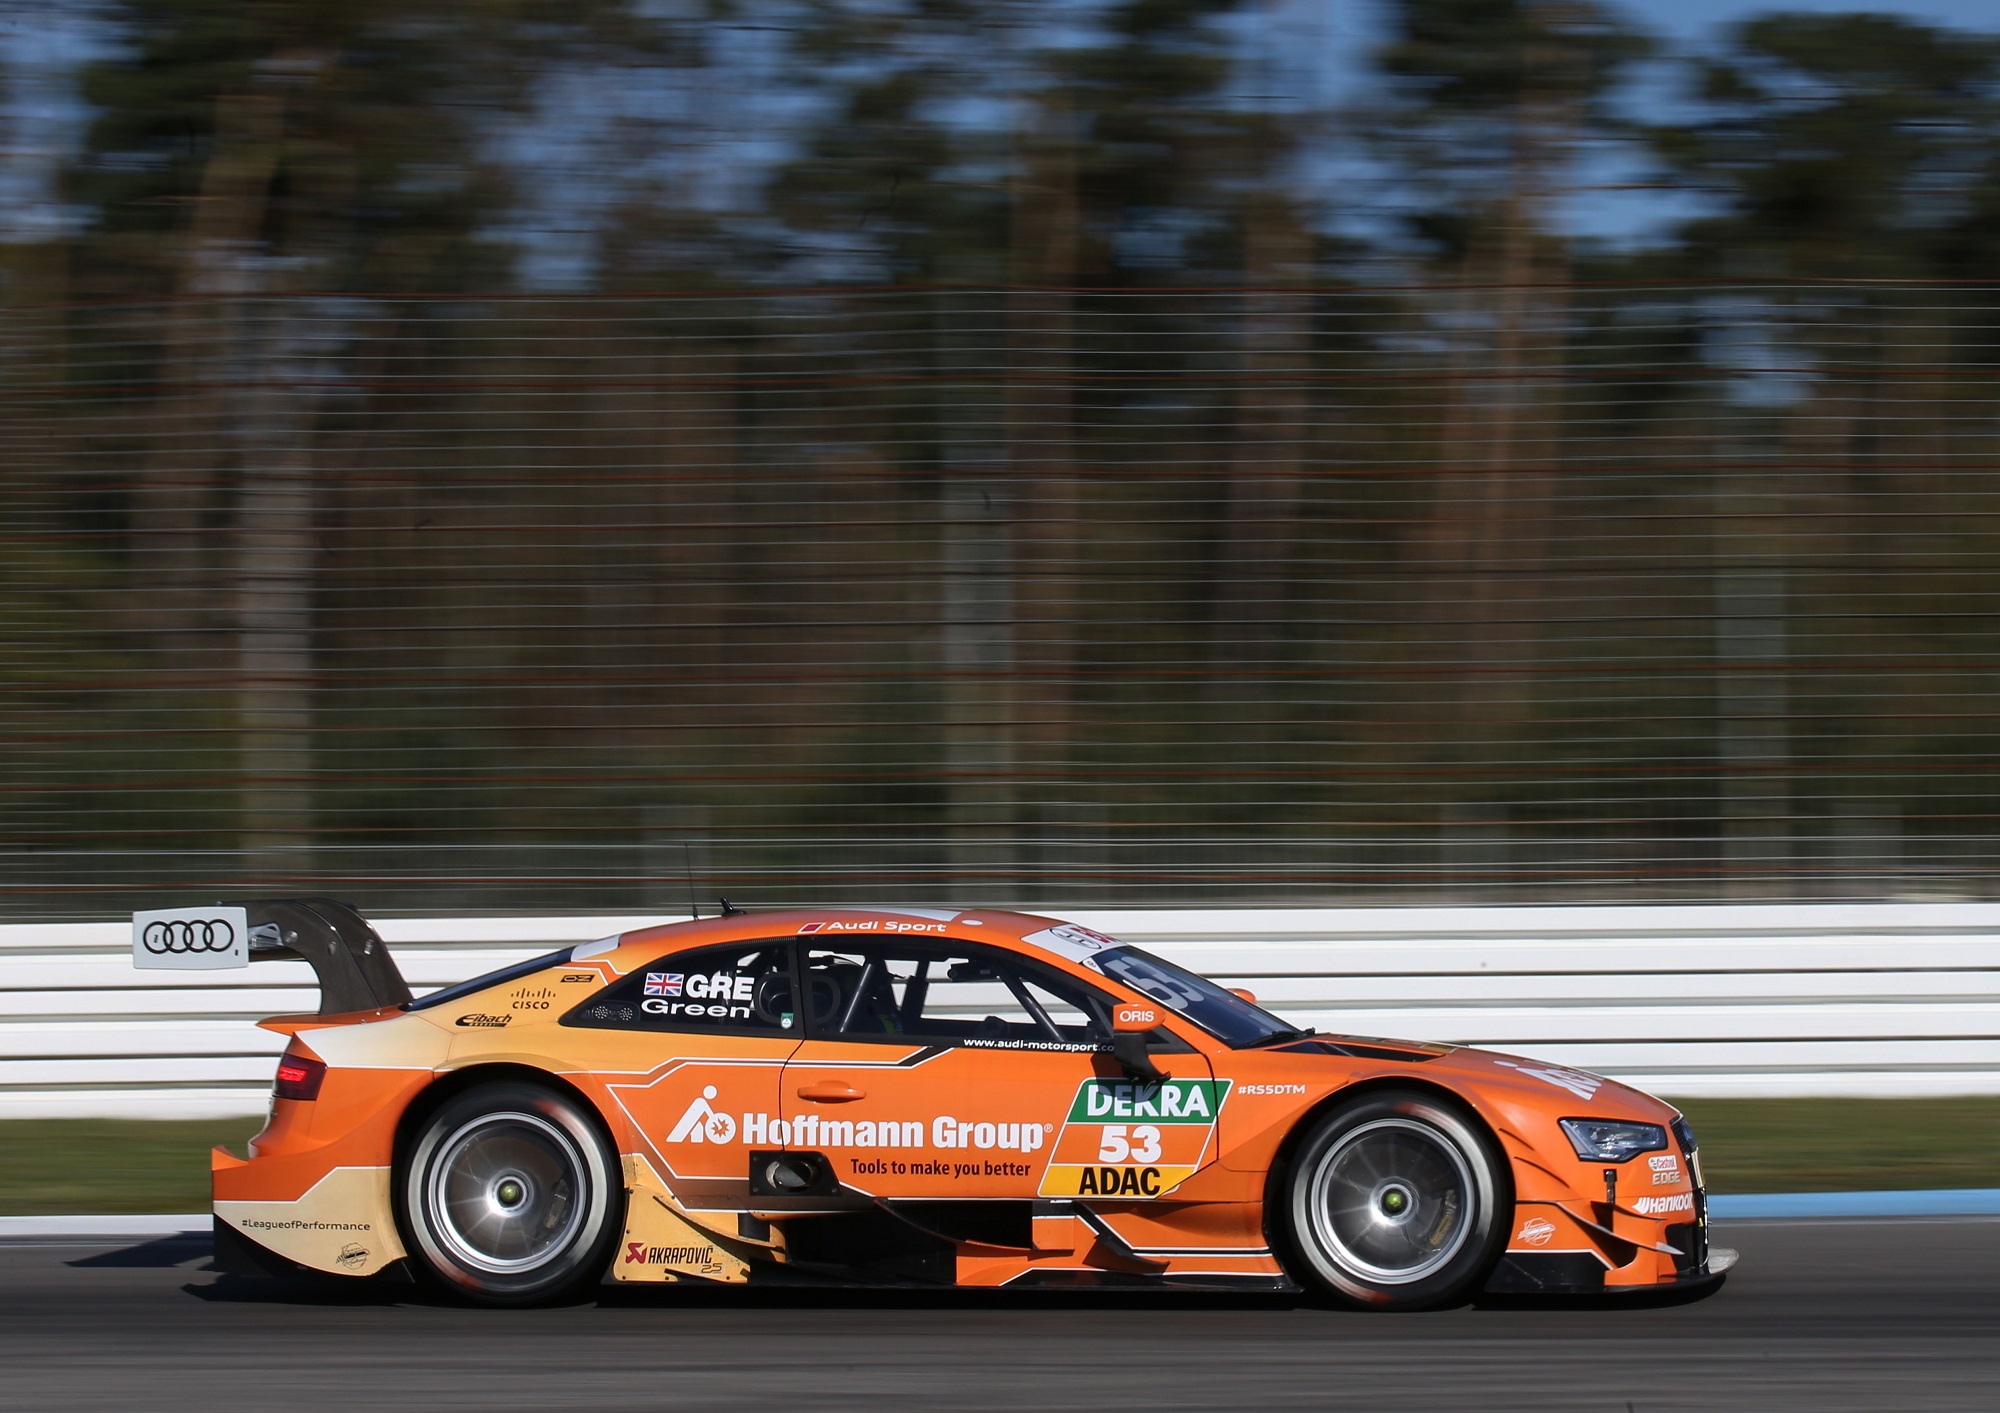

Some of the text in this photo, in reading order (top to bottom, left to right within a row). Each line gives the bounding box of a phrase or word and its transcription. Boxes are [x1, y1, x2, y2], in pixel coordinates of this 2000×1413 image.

[827, 921, 947, 933] Audi Sport
[686, 974, 755, 1001] GRE
[641, 998, 751, 1019] Green
[1119, 1010, 1155, 1023] ORIS
[455, 1013, 513, 1027] Eibach
[963, 1038, 1115, 1053] www.audi-motorsport.co
[1237, 1084, 1306, 1095] #RS5DTM
[1087, 1083, 1210, 1118] DEKRA
[742, 1112, 925, 1148] Hoffmann
[1098, 1125, 1163, 1164] 53
[850, 1158, 1031, 1179] Tools to make you better
[1078, 1167, 1161, 1196] ADAC
[1652, 1171, 1681, 1186] EDGE
[241, 1218, 371, 1232] #LeagueofPerformance
